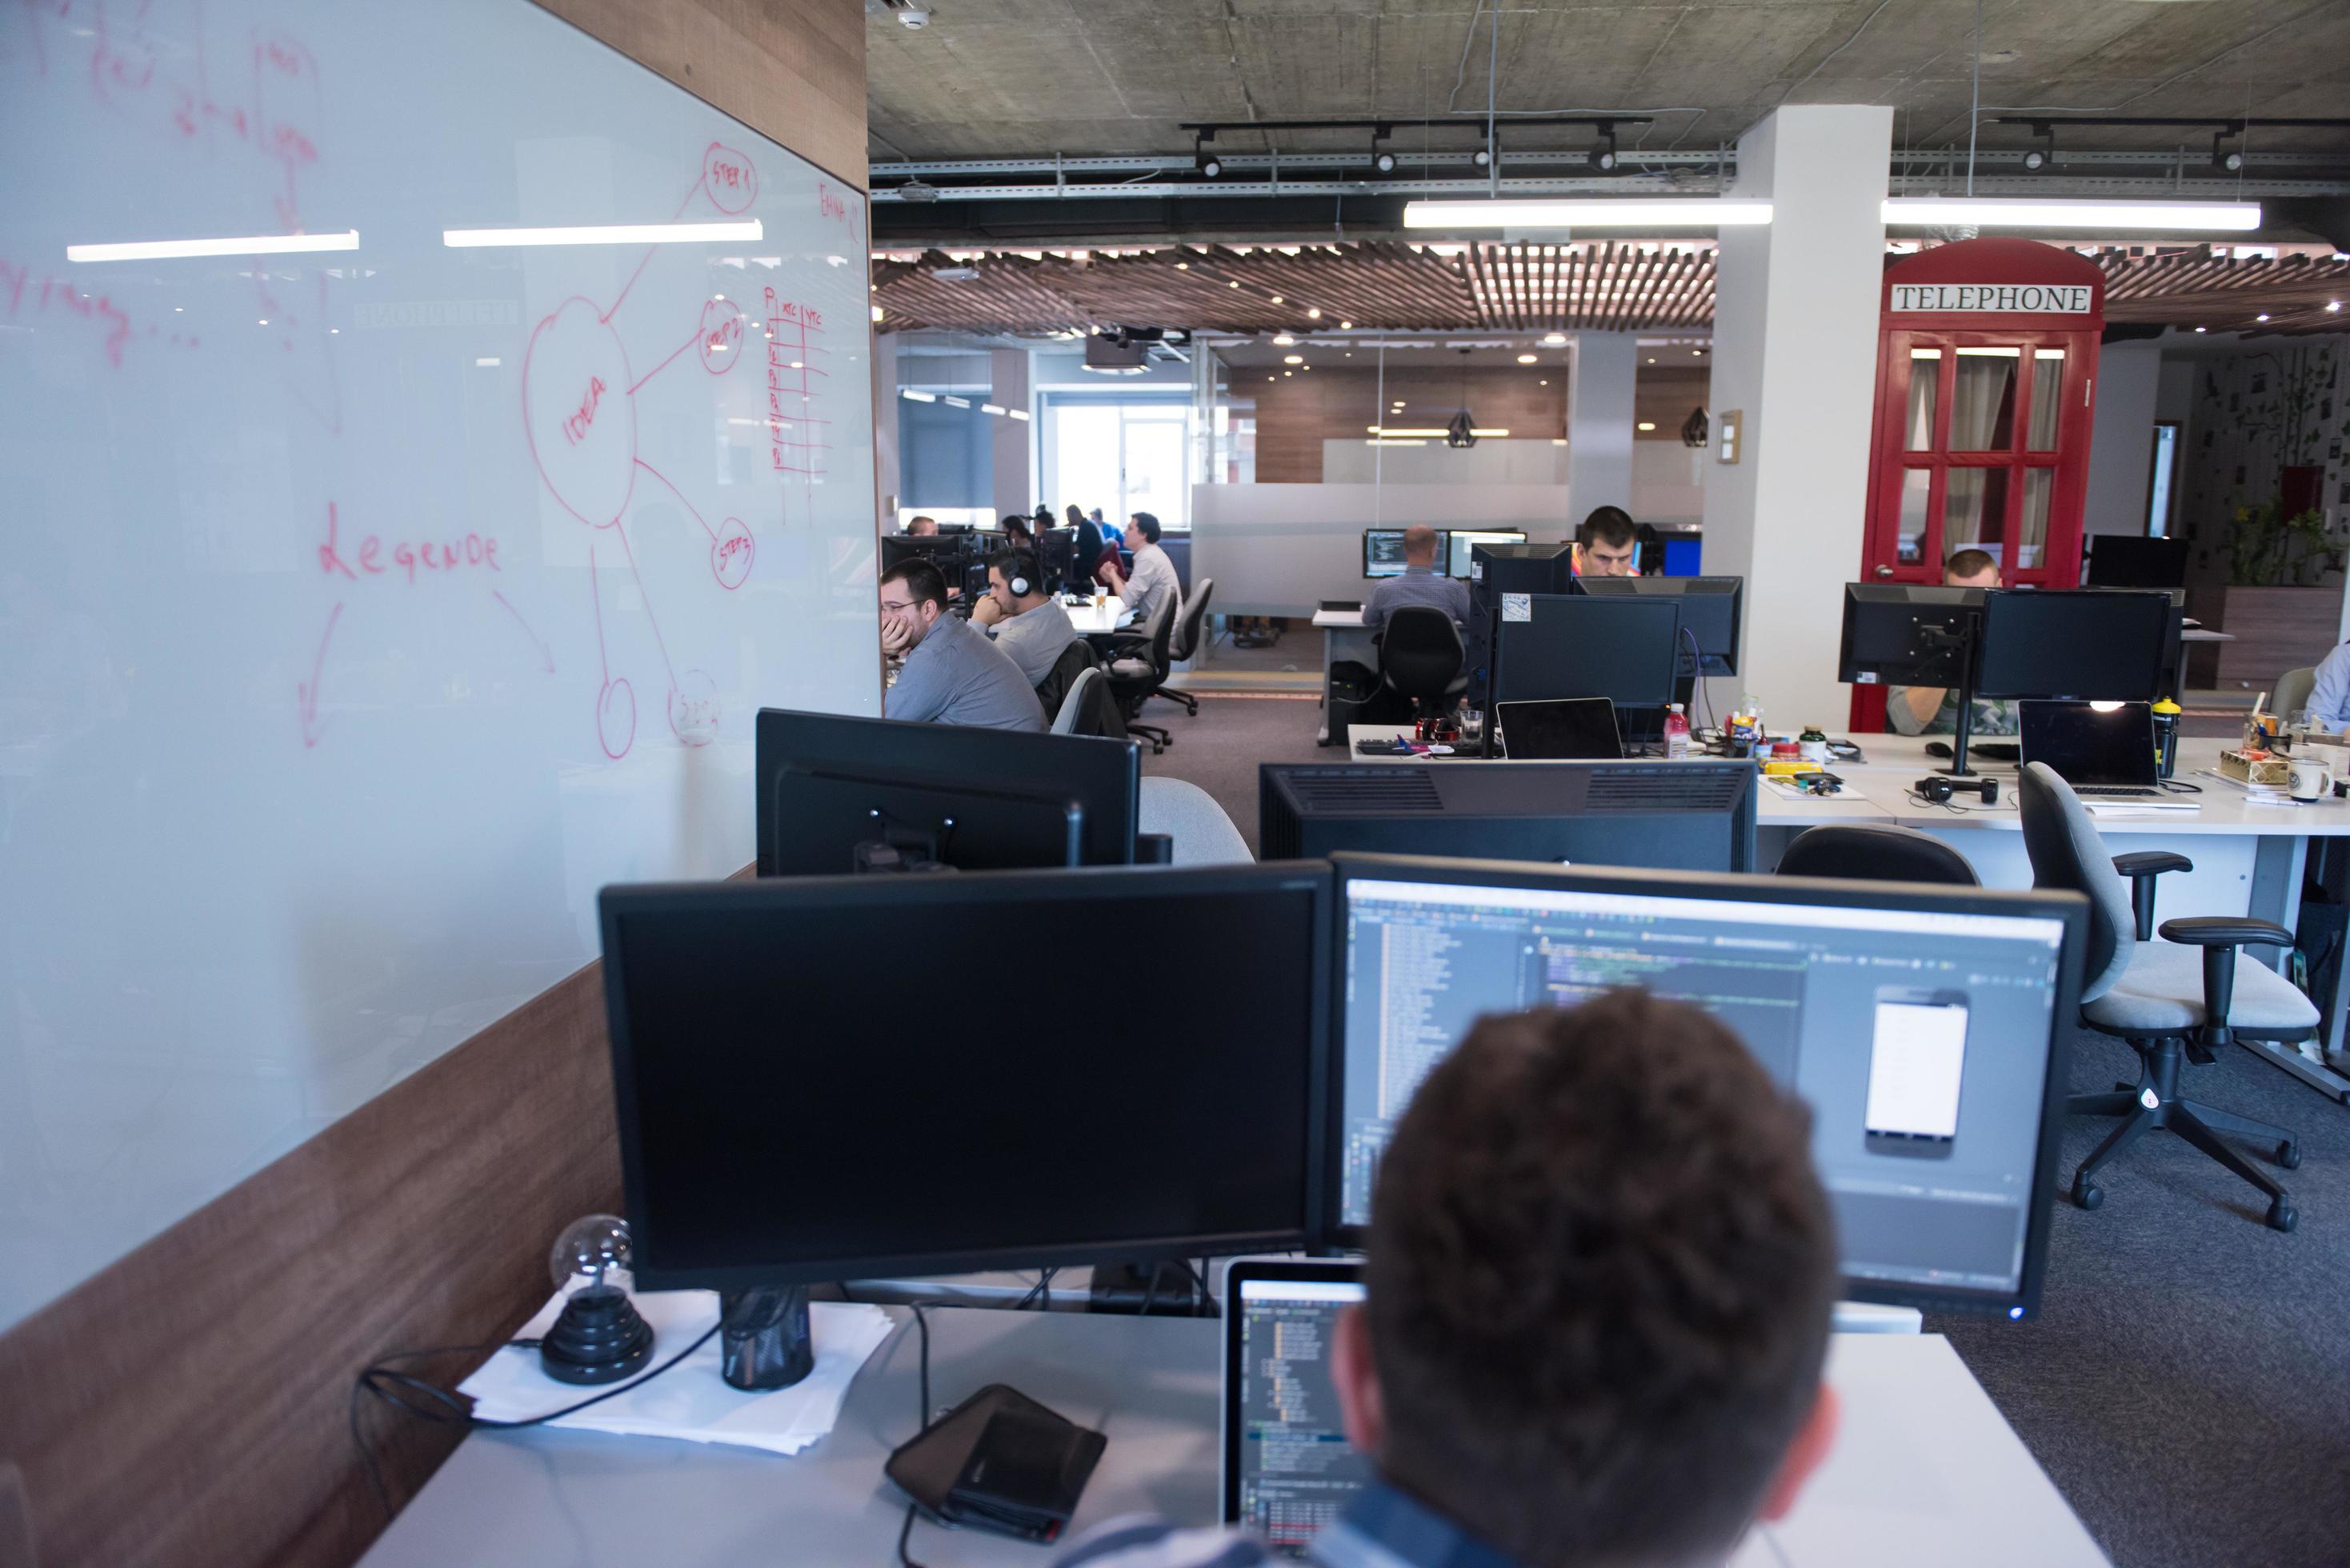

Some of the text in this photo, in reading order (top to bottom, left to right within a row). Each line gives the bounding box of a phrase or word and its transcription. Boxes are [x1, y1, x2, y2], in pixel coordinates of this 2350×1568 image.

[713, 160, 739, 189] STEP
[1896, 286, 2088, 312] TELEPHONE
[562, 374, 607, 446] IDEA
[719, 537, 743, 571] STEP
